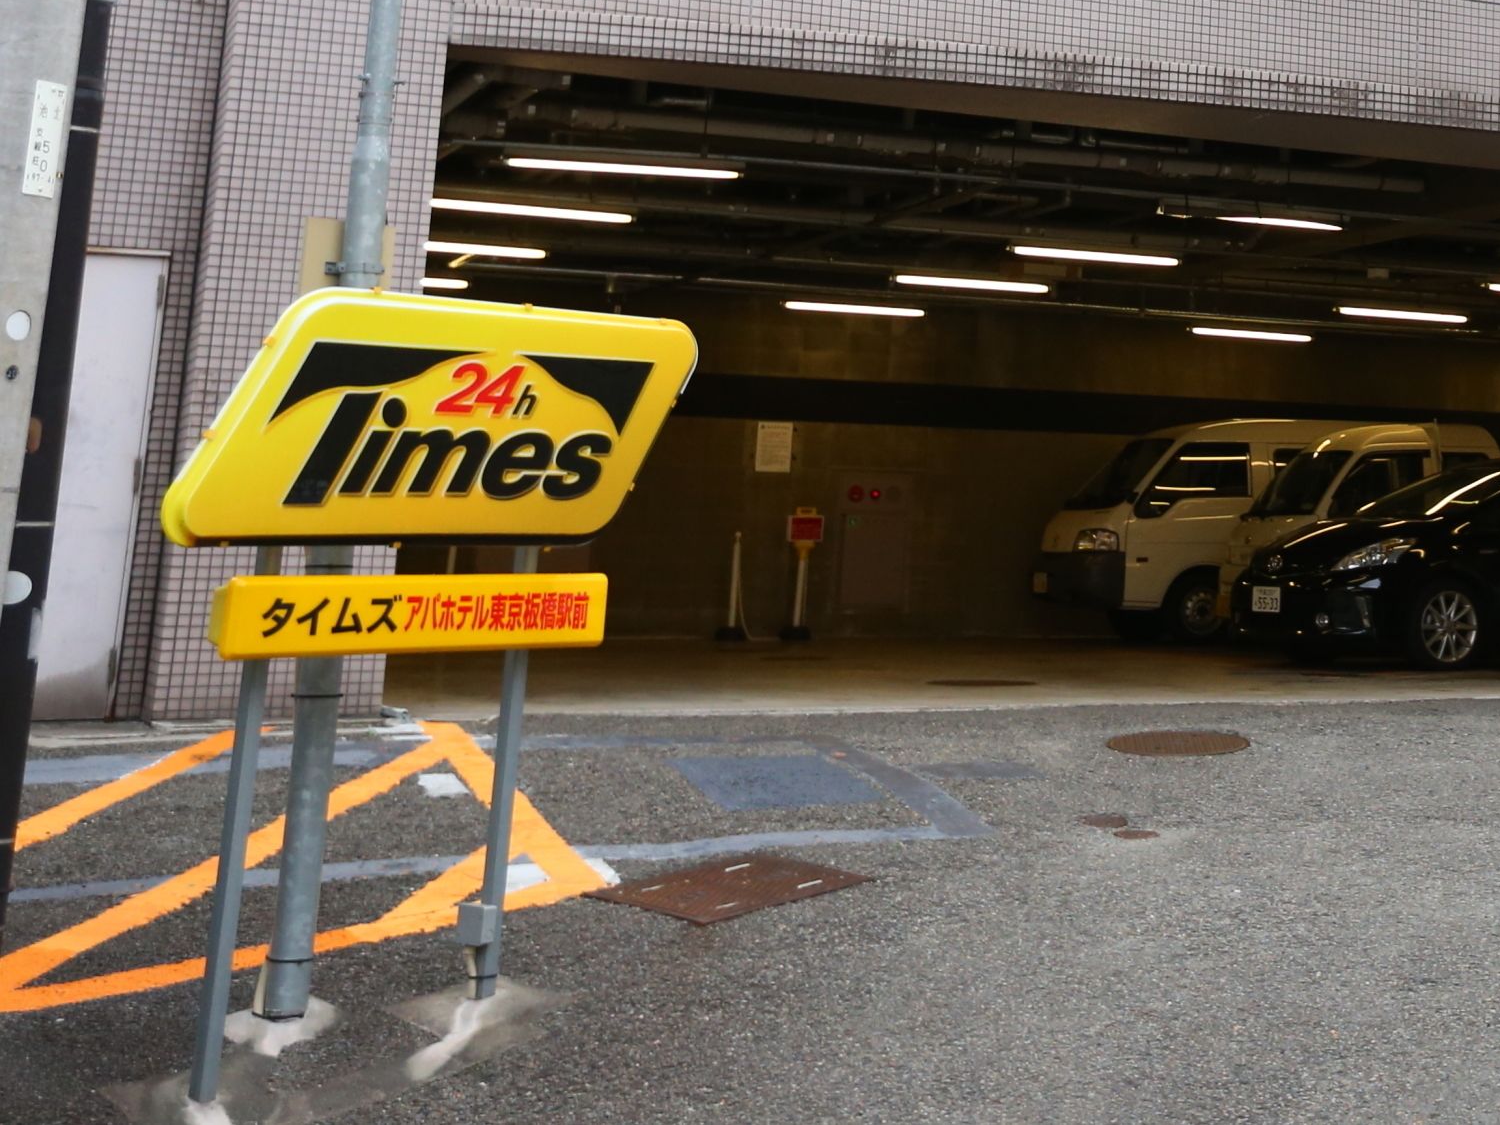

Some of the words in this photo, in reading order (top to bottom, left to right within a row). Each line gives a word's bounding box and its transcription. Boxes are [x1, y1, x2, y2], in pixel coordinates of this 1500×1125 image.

[434, 362, 537, 418] 24h
[283, 391, 613, 507] Times
[261, 594, 402, 638] タイムズ
[403, 591, 590, 633] アパホテル東京板橋駅前
